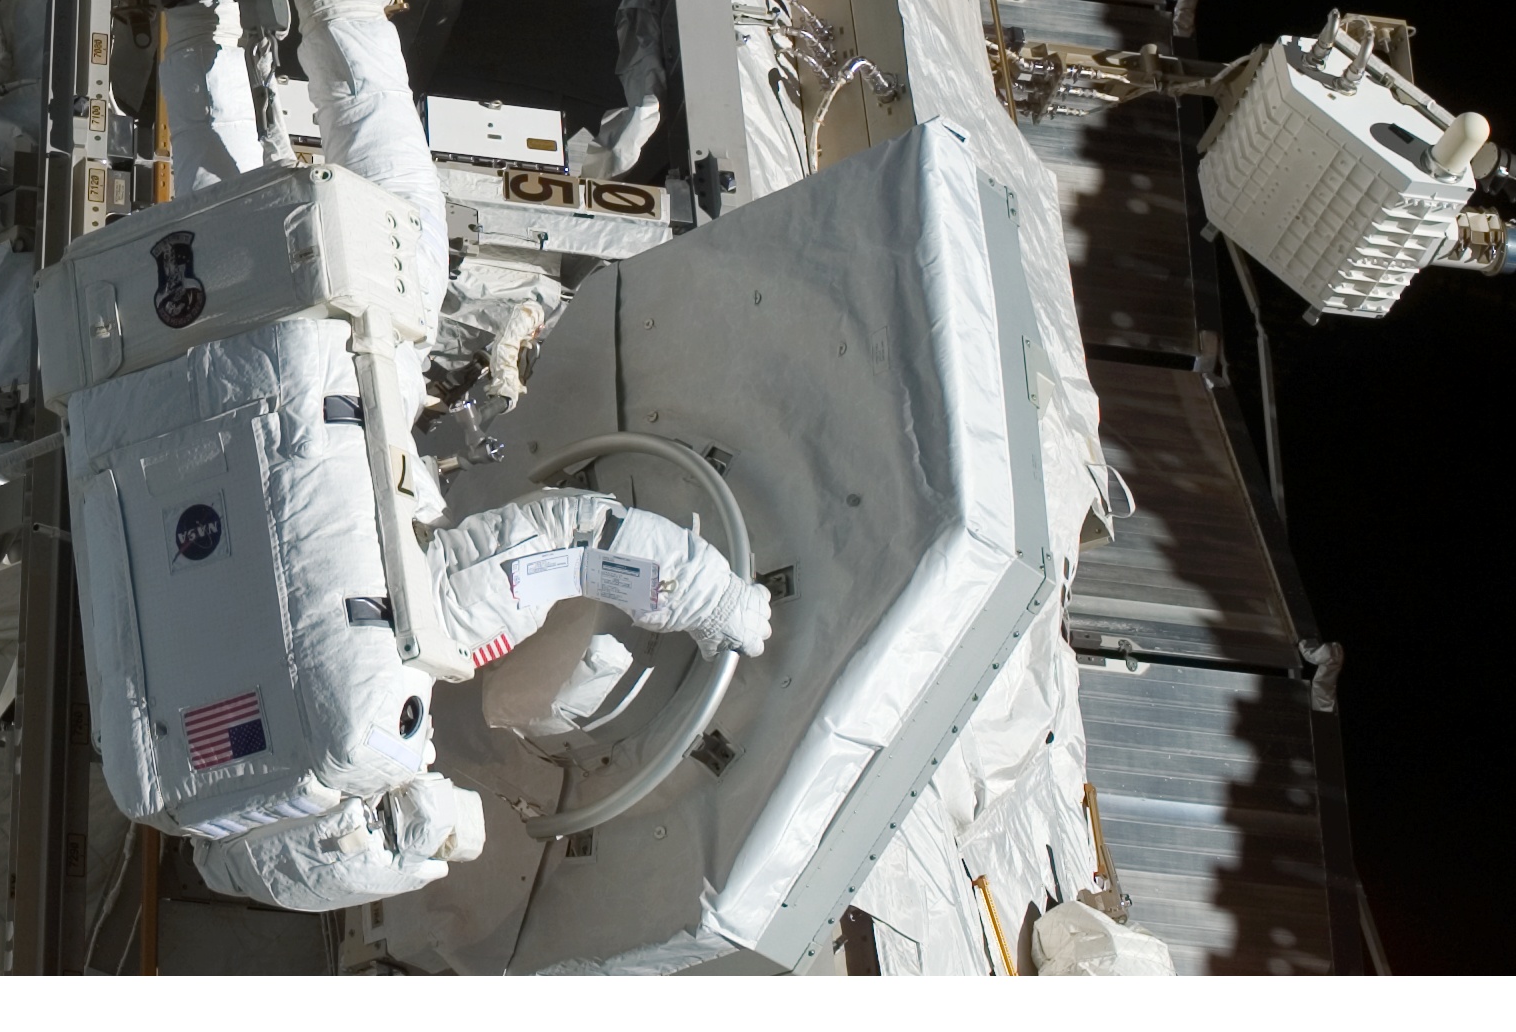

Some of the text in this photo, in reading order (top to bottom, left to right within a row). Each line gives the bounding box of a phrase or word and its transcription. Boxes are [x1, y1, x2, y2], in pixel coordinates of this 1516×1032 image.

[91, 106, 101, 125] 7100
[90, 175, 99, 195] 7120
[177, 521, 218, 544] NASA
[68, 842, 79, 868] 7290
